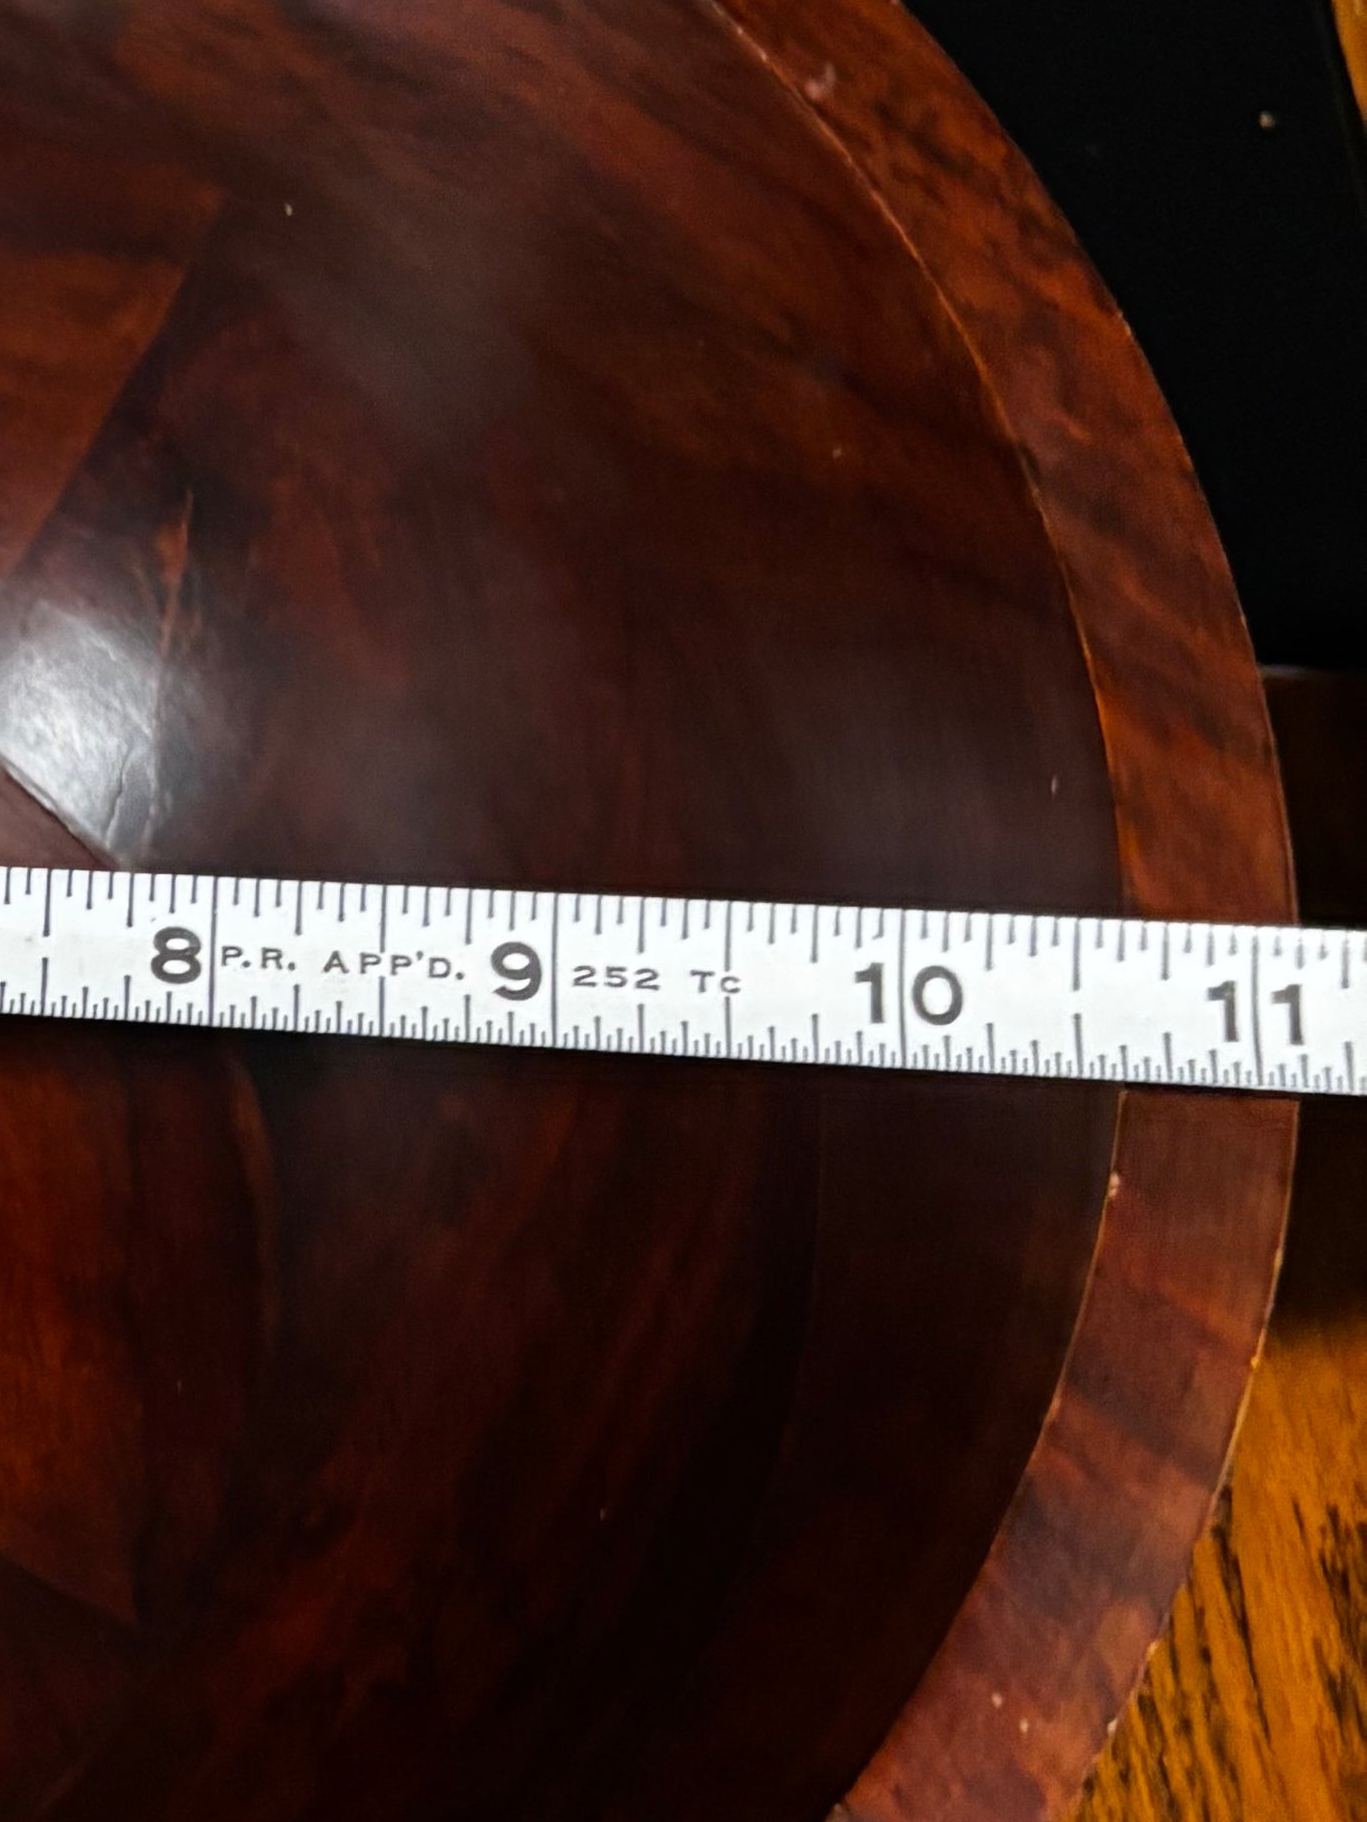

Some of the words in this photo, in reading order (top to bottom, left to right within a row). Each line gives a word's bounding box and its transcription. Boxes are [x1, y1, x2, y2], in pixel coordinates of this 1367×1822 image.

[151, 927, 202, 984] 8
[222, 946, 296, 971] P.R.
[491, 941, 542, 1000] 9
[572, 965, 660, 991] 252
[854, 962, 964, 1026] 10
[1207, 980, 1304, 1046] 11
